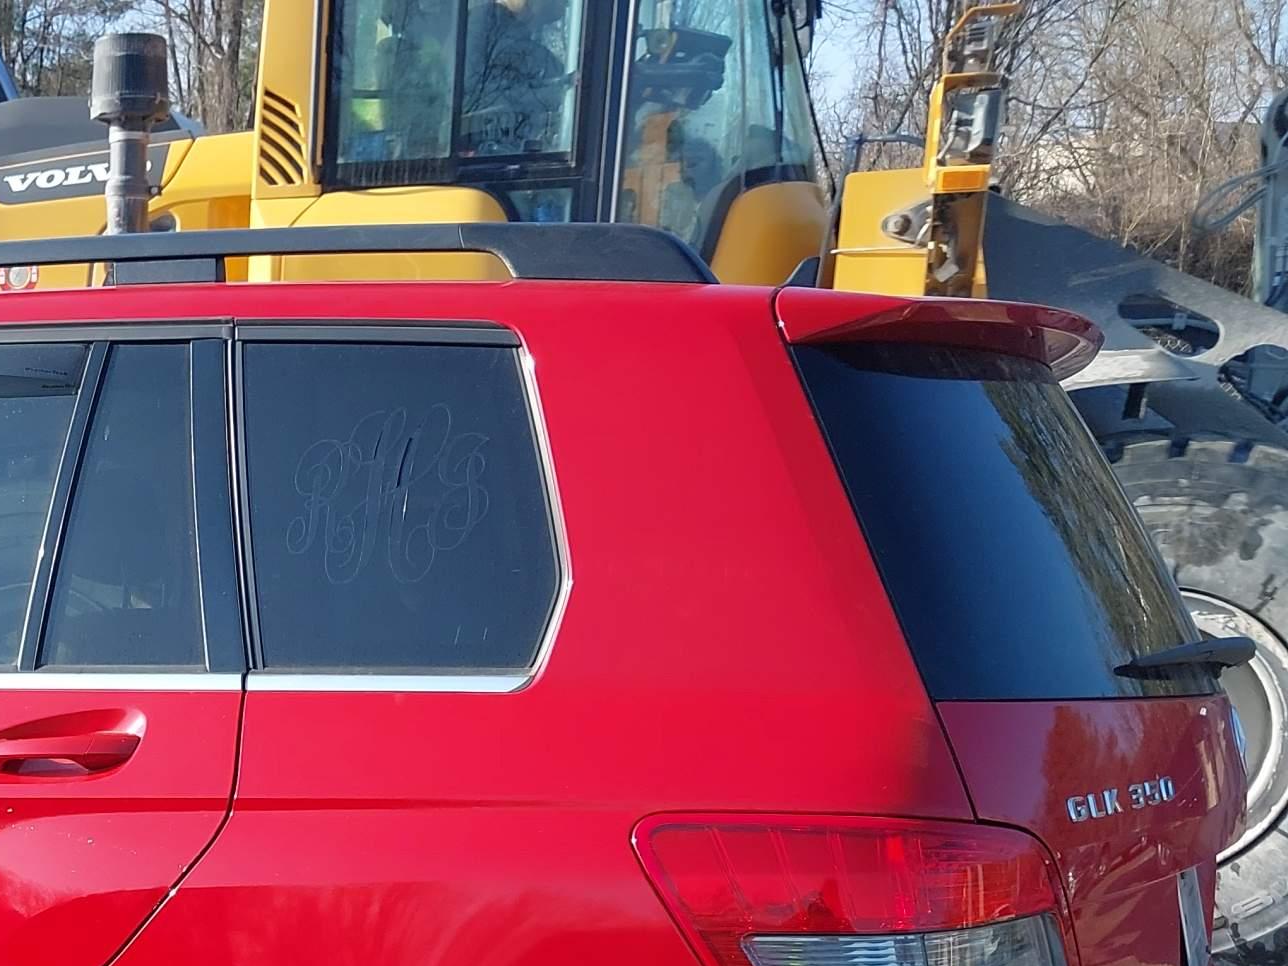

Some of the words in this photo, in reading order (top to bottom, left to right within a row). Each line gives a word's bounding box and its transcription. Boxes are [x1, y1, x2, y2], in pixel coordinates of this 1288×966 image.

[3, 159, 153, 193] VOLV
[1066, 788, 1123, 823] GLK
[1128, 776, 1175, 810] 350
